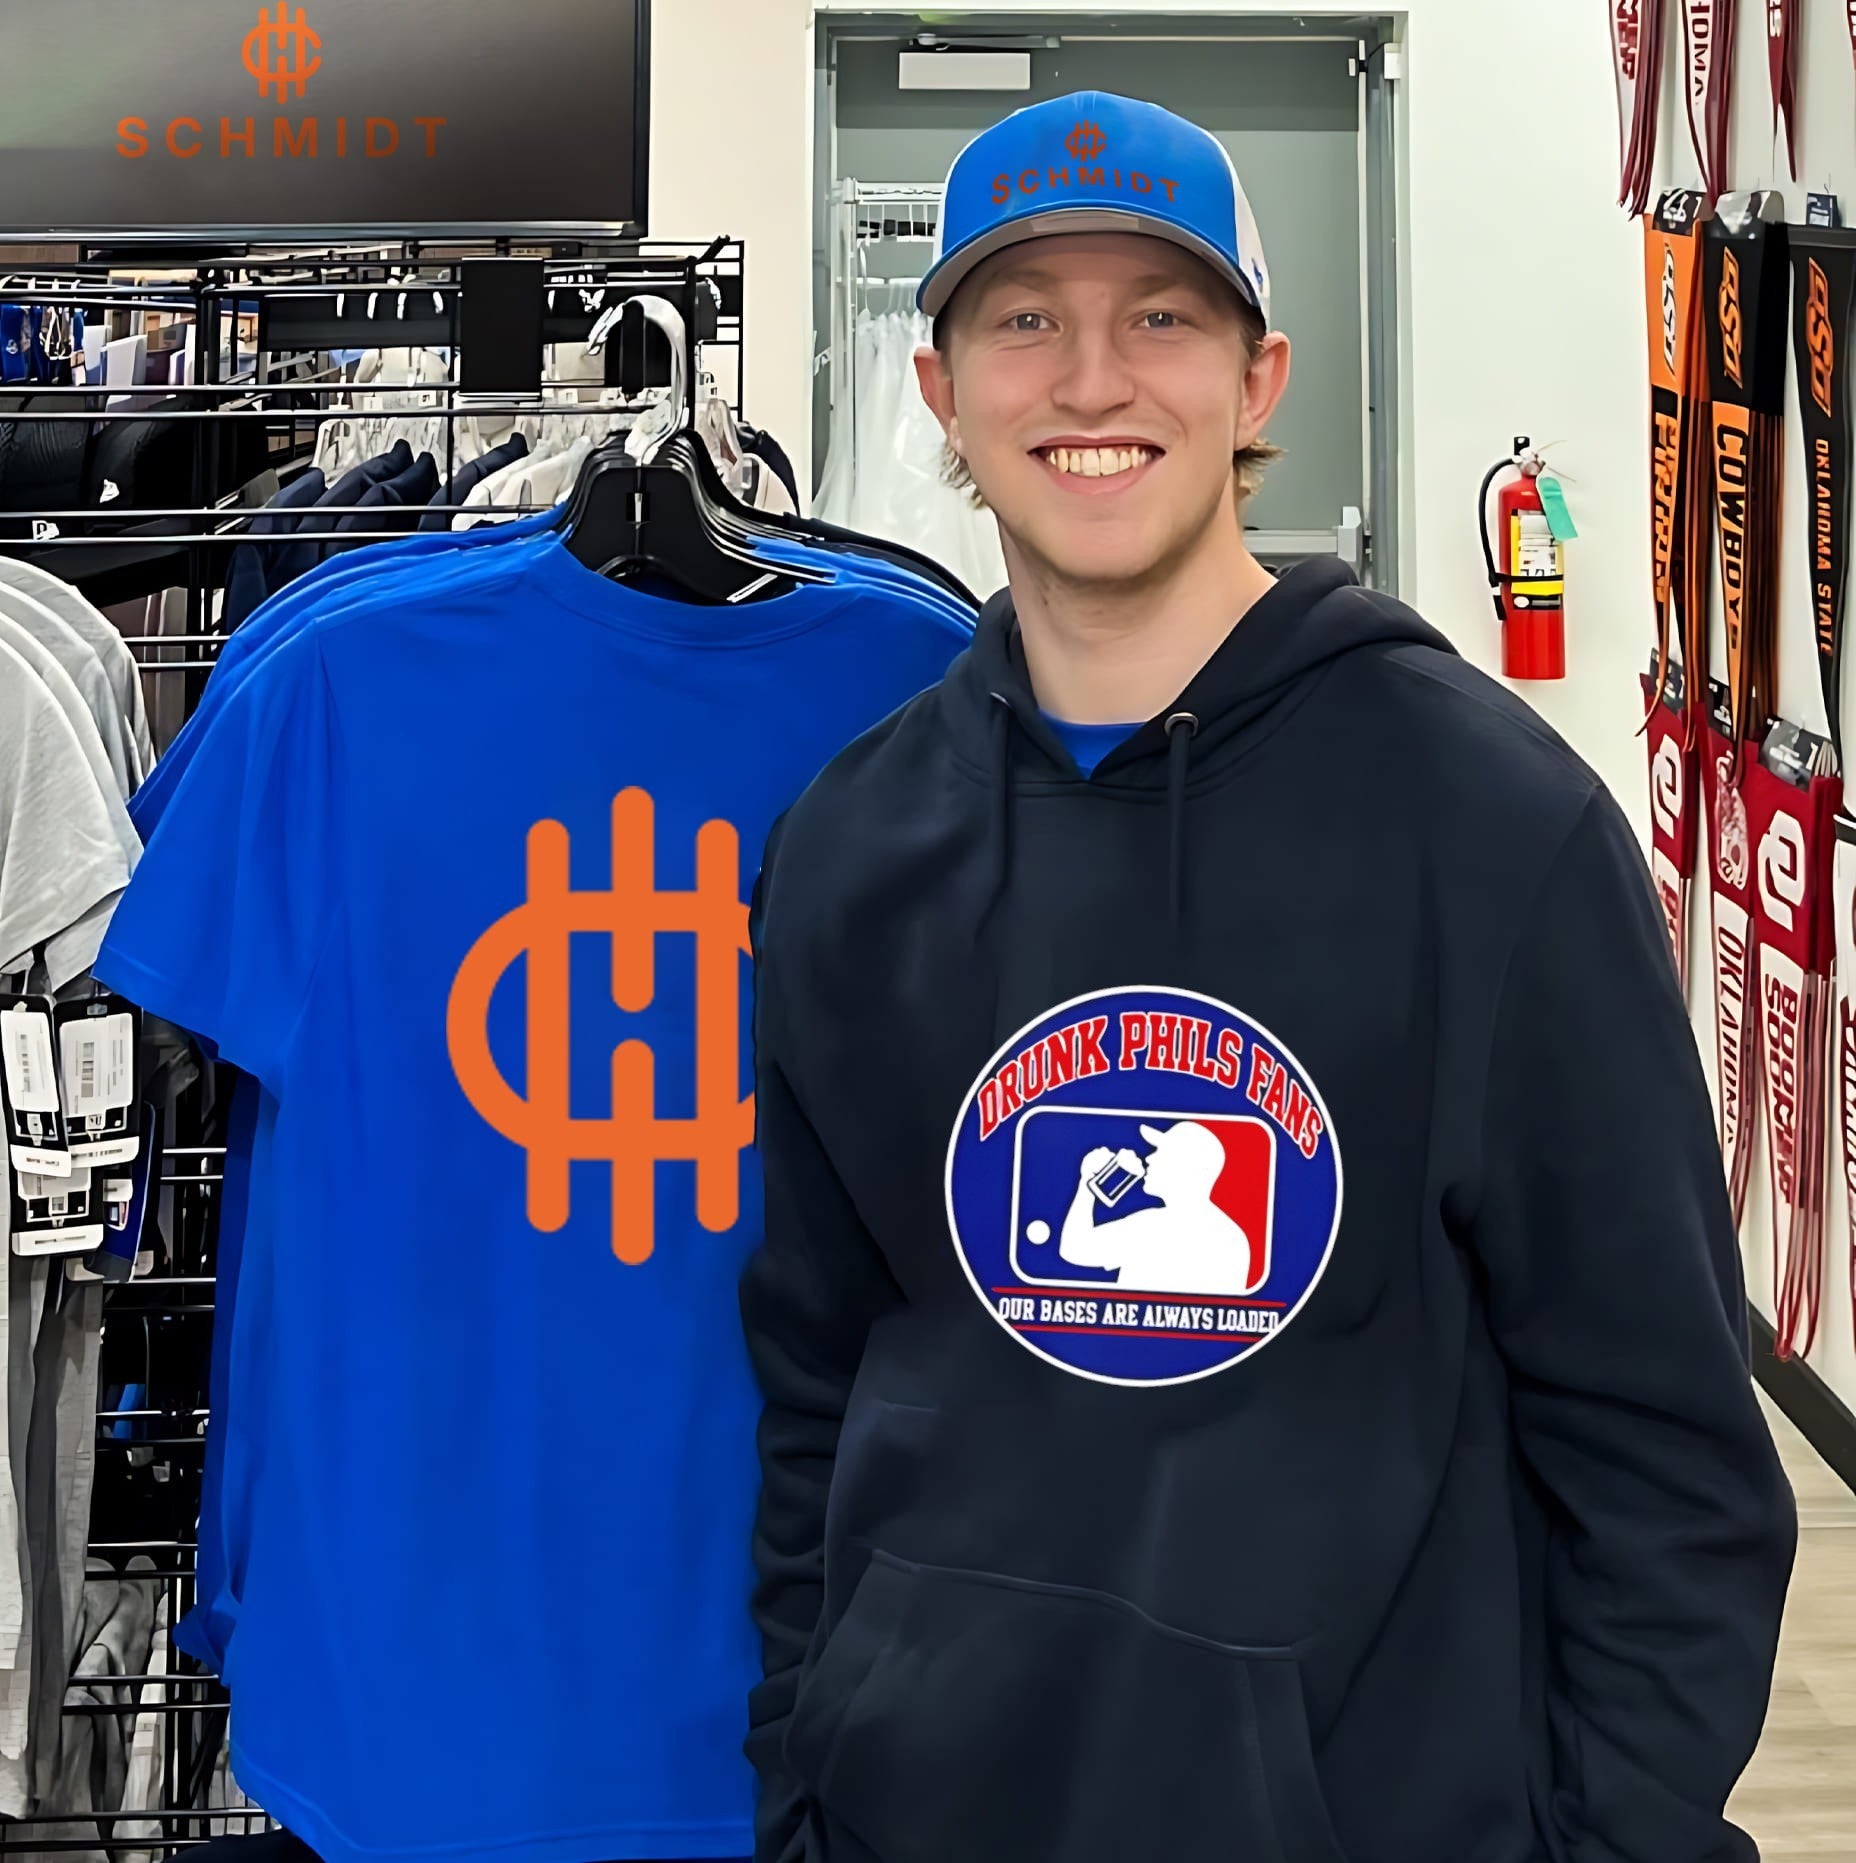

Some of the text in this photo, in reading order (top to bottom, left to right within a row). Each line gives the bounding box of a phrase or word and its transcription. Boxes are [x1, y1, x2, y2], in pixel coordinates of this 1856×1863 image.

[115, 116, 447, 159] SCHMIDT
[991, 167, 1179, 204] SCHMIDT
[1815, 438, 1832, 570] OKLAHOMA
[977, 1011, 1324, 1160] DRUNK PHILS FANS
[1718, 925, 1744, 1144] OKLAHOMA
[1779, 983, 1798, 1203] BOOM
[999, 1297, 1280, 1334] OUR BASES ARE ALWAYS LOADED
